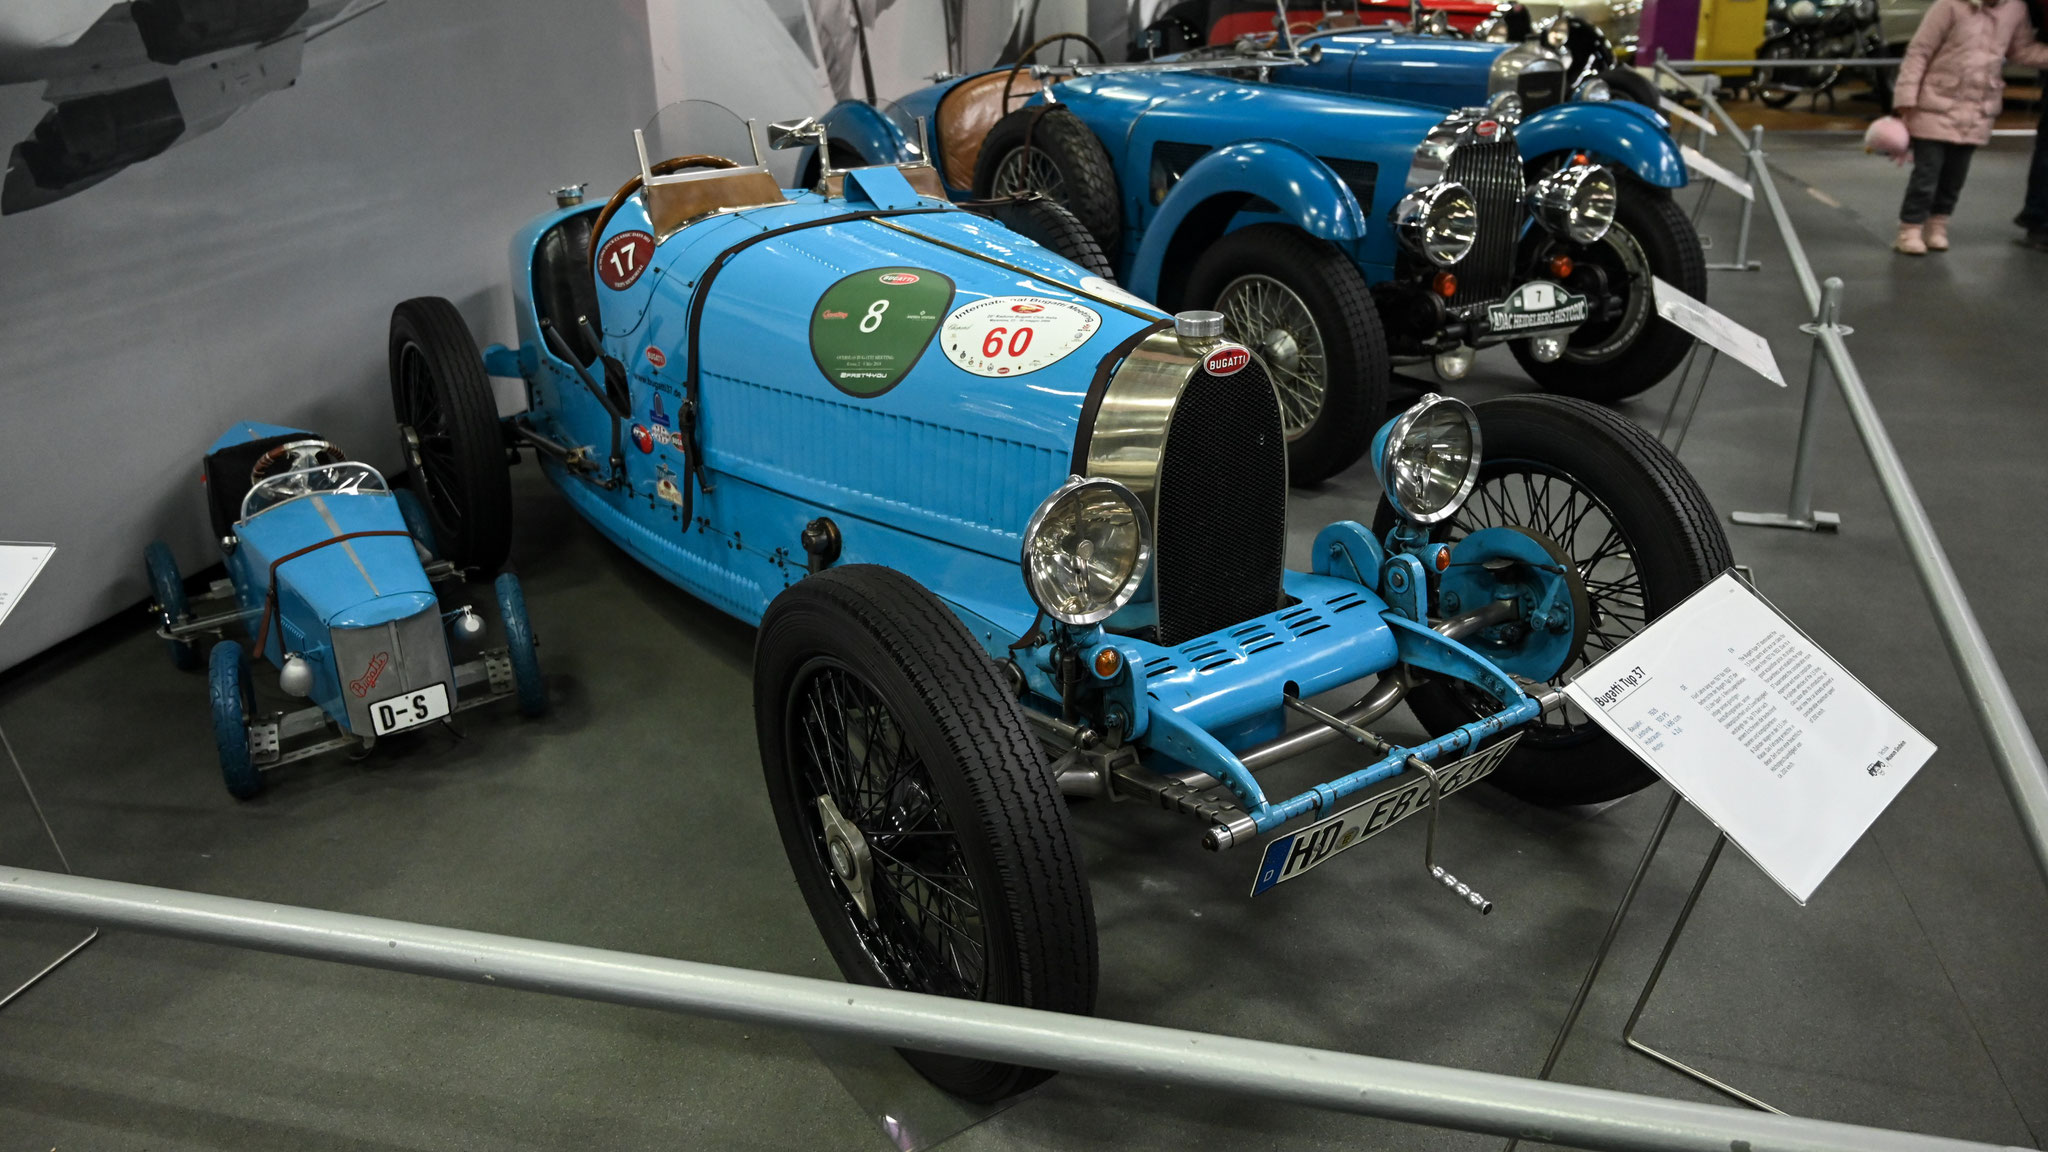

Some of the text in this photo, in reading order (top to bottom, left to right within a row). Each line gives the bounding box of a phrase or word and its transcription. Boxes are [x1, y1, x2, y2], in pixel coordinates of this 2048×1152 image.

[610, 242, 636, 277] 17
[1030, 298, 1067, 308] Bugatti
[1068, 304, 1094, 323] Meeting
[1536, 290, 1542, 303] 7
[859, 300, 890, 334] 8
[1494, 301, 1586, 332] ADAC HEIDELBERG HISTORIC
[982, 327, 1034, 358] 60
[1210, 355, 1246, 370] BUGATTI
[350, 652, 389, 698] Bugatti
[1594, 666, 1646, 707] Bugatti Typ 37
[1283, 818, 1344, 876] HD
[1264, 870, 1274, 882] D
